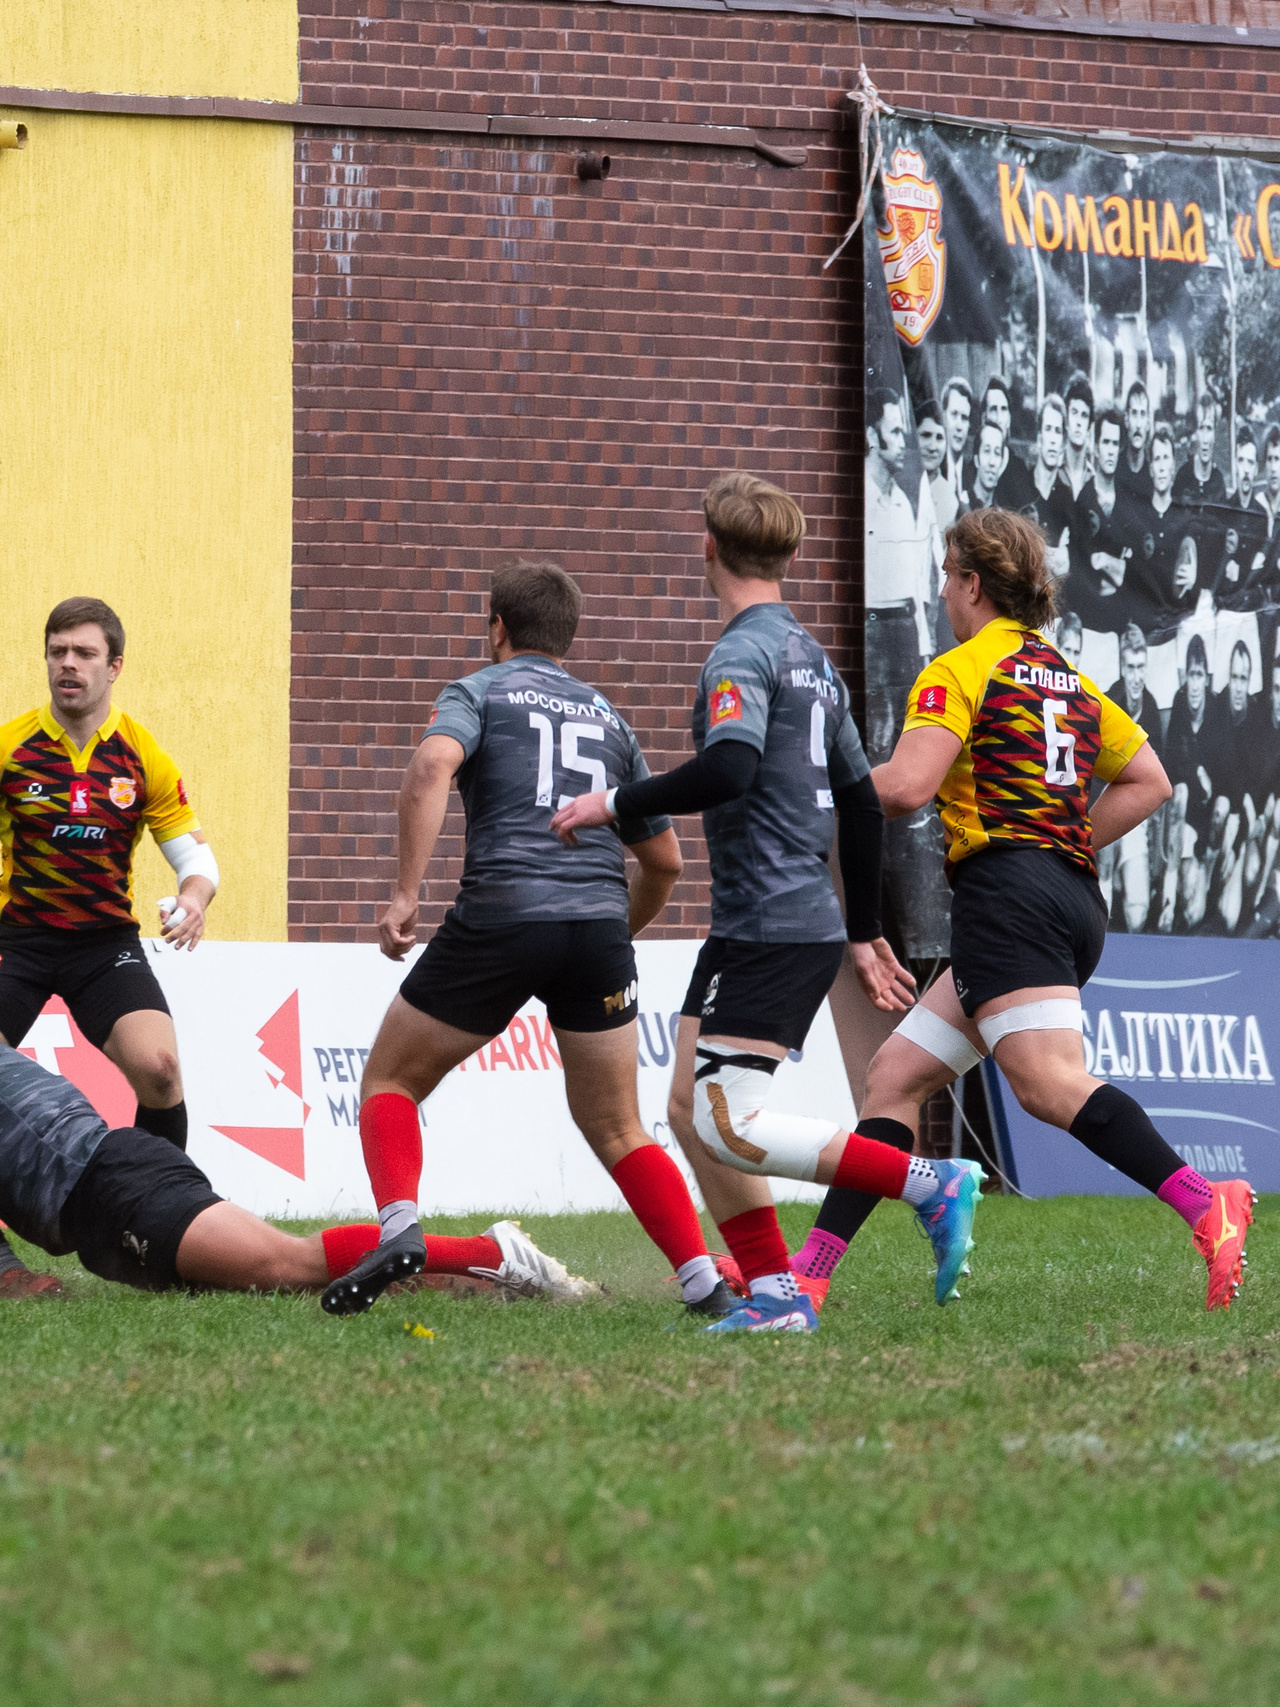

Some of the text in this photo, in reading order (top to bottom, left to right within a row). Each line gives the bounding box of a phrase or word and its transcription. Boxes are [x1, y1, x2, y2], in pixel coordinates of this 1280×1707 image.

[998, 163, 1209, 263] Команда
[507, 690, 620, 730] МОСОБЛГАЗ
[1014, 664, 1080, 693] СЛАВА
[529, 712, 607, 810] 15
[1043, 698, 1077, 786] 6
[52, 825, 106, 839] PARI
